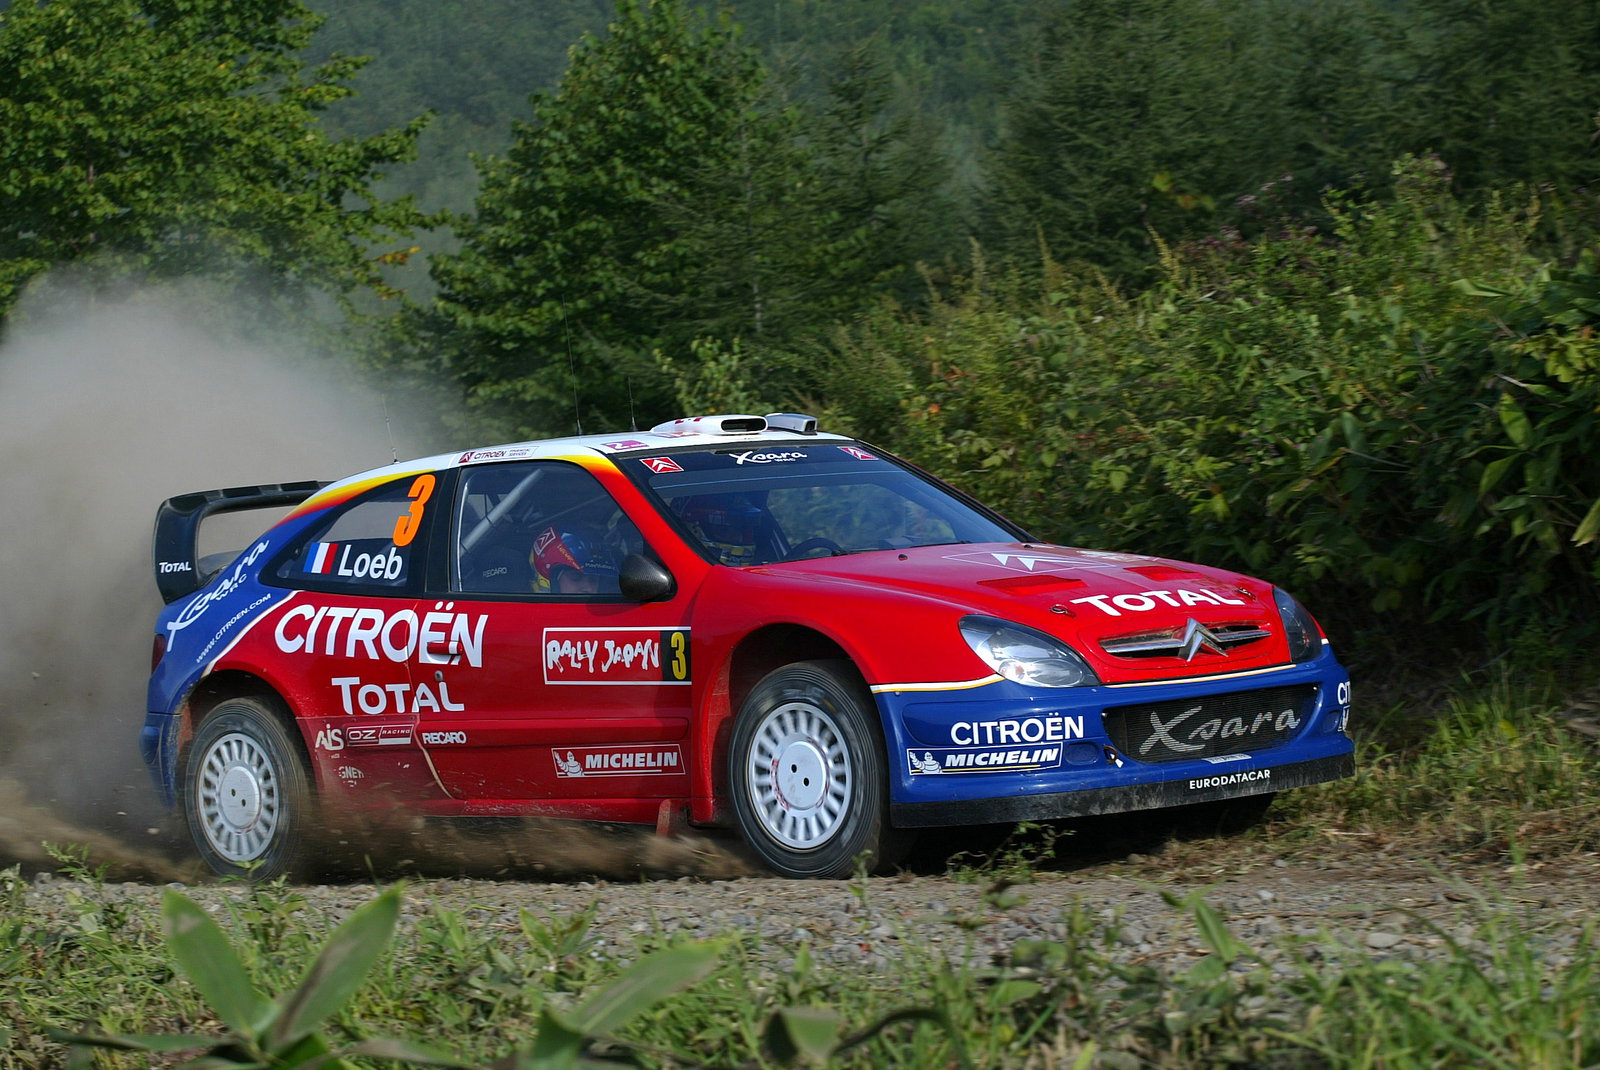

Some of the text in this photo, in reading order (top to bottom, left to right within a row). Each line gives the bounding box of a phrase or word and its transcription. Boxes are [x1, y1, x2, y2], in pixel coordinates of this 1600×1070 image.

[728, 451, 807, 464] Xsara
[393, 474, 436, 547] 3
[159, 561, 192, 573] TOTAL
[338, 544, 403, 580] Loeb
[1070, 588, 1246, 617] TOTAL
[274, 601, 488, 668] CITROËN
[546, 638, 660, 673] RALLY JAPAN
[670, 631, 687, 680] 3
[331, 676, 465, 716] TOTAL
[422, 731, 467, 745] RECARO
[951, 712, 1084, 745] CITROËN
[1139, 706, 1301, 755] Xsara
[585, 752, 678, 769] MICHELIN
[944, 748, 1060, 767] MICHELIN
[1189, 769, 1271, 790] EURODATACAR
